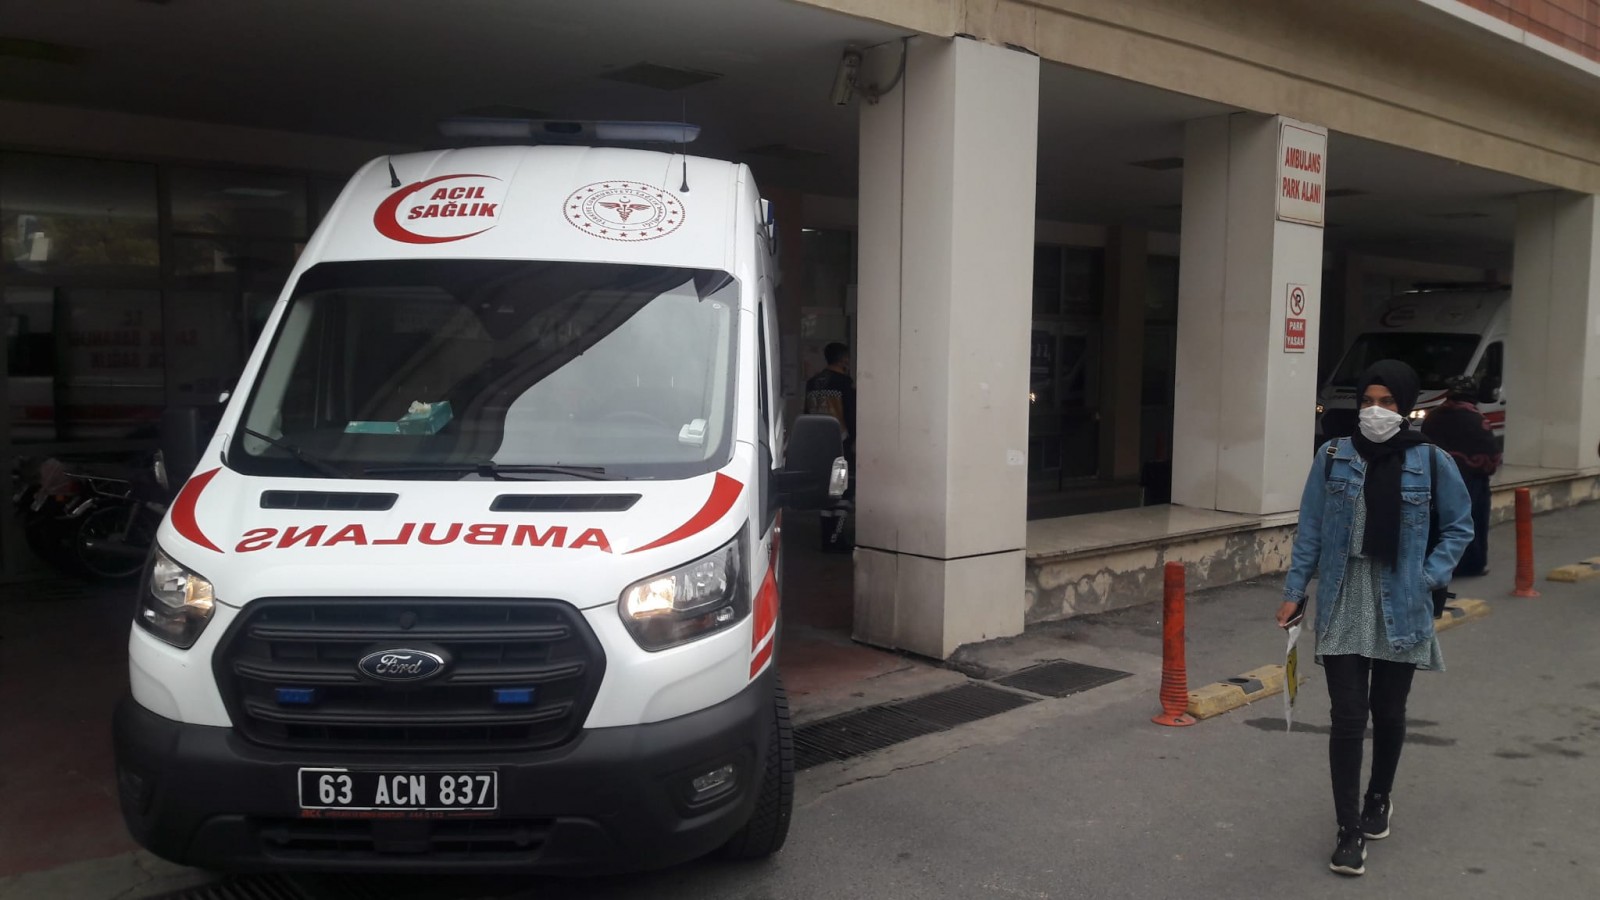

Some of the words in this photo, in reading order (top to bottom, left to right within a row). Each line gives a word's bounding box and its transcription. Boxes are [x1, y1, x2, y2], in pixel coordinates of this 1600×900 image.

[1285, 146, 1321, 174] AMBULANS
[1282, 177, 1300, 200] PARK
[1301, 180, 1321, 204] ALANI
[407, 201, 498, 220] SAĞLIK
[1289, 321, 1303, 331] PARK
[1287, 335, 1304, 346] YASAK
[376, 654, 422, 674] Ford
[318, 774, 353, 805] 63
[375, 775, 426, 805] ACN
[439, 775, 491, 805] 837
